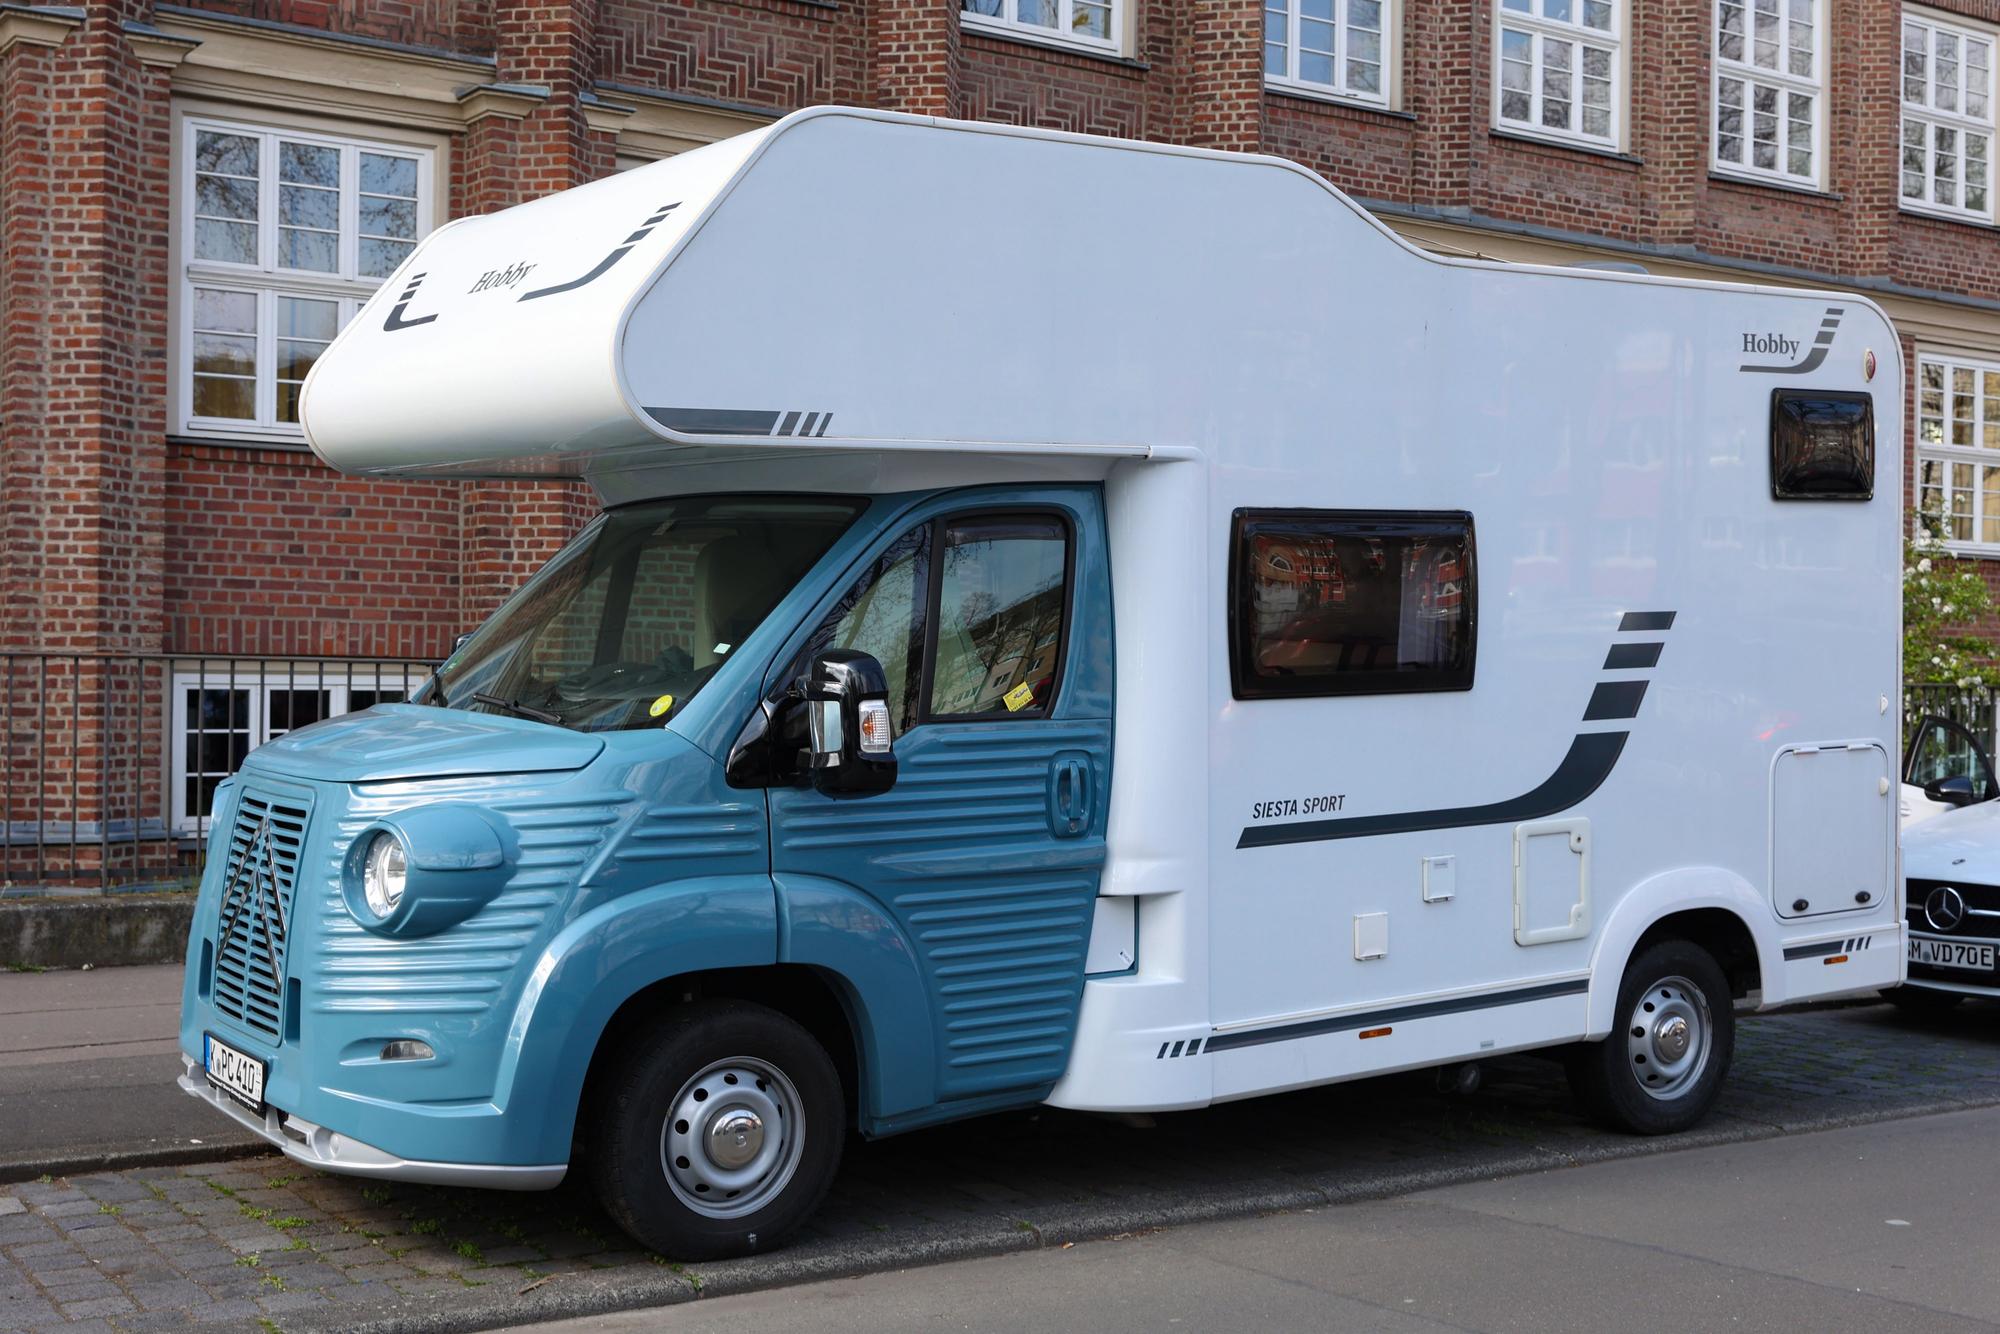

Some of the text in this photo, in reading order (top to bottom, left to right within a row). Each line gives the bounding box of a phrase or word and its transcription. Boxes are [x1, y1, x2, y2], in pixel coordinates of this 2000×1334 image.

[467, 260, 538, 294] Hobby
[1742, 333, 1800, 360] Hobby
[1252, 794, 1346, 819] SIESTA SPORT
[210, 1041, 217, 1073] K
[236, 1058, 255, 1094] 410
